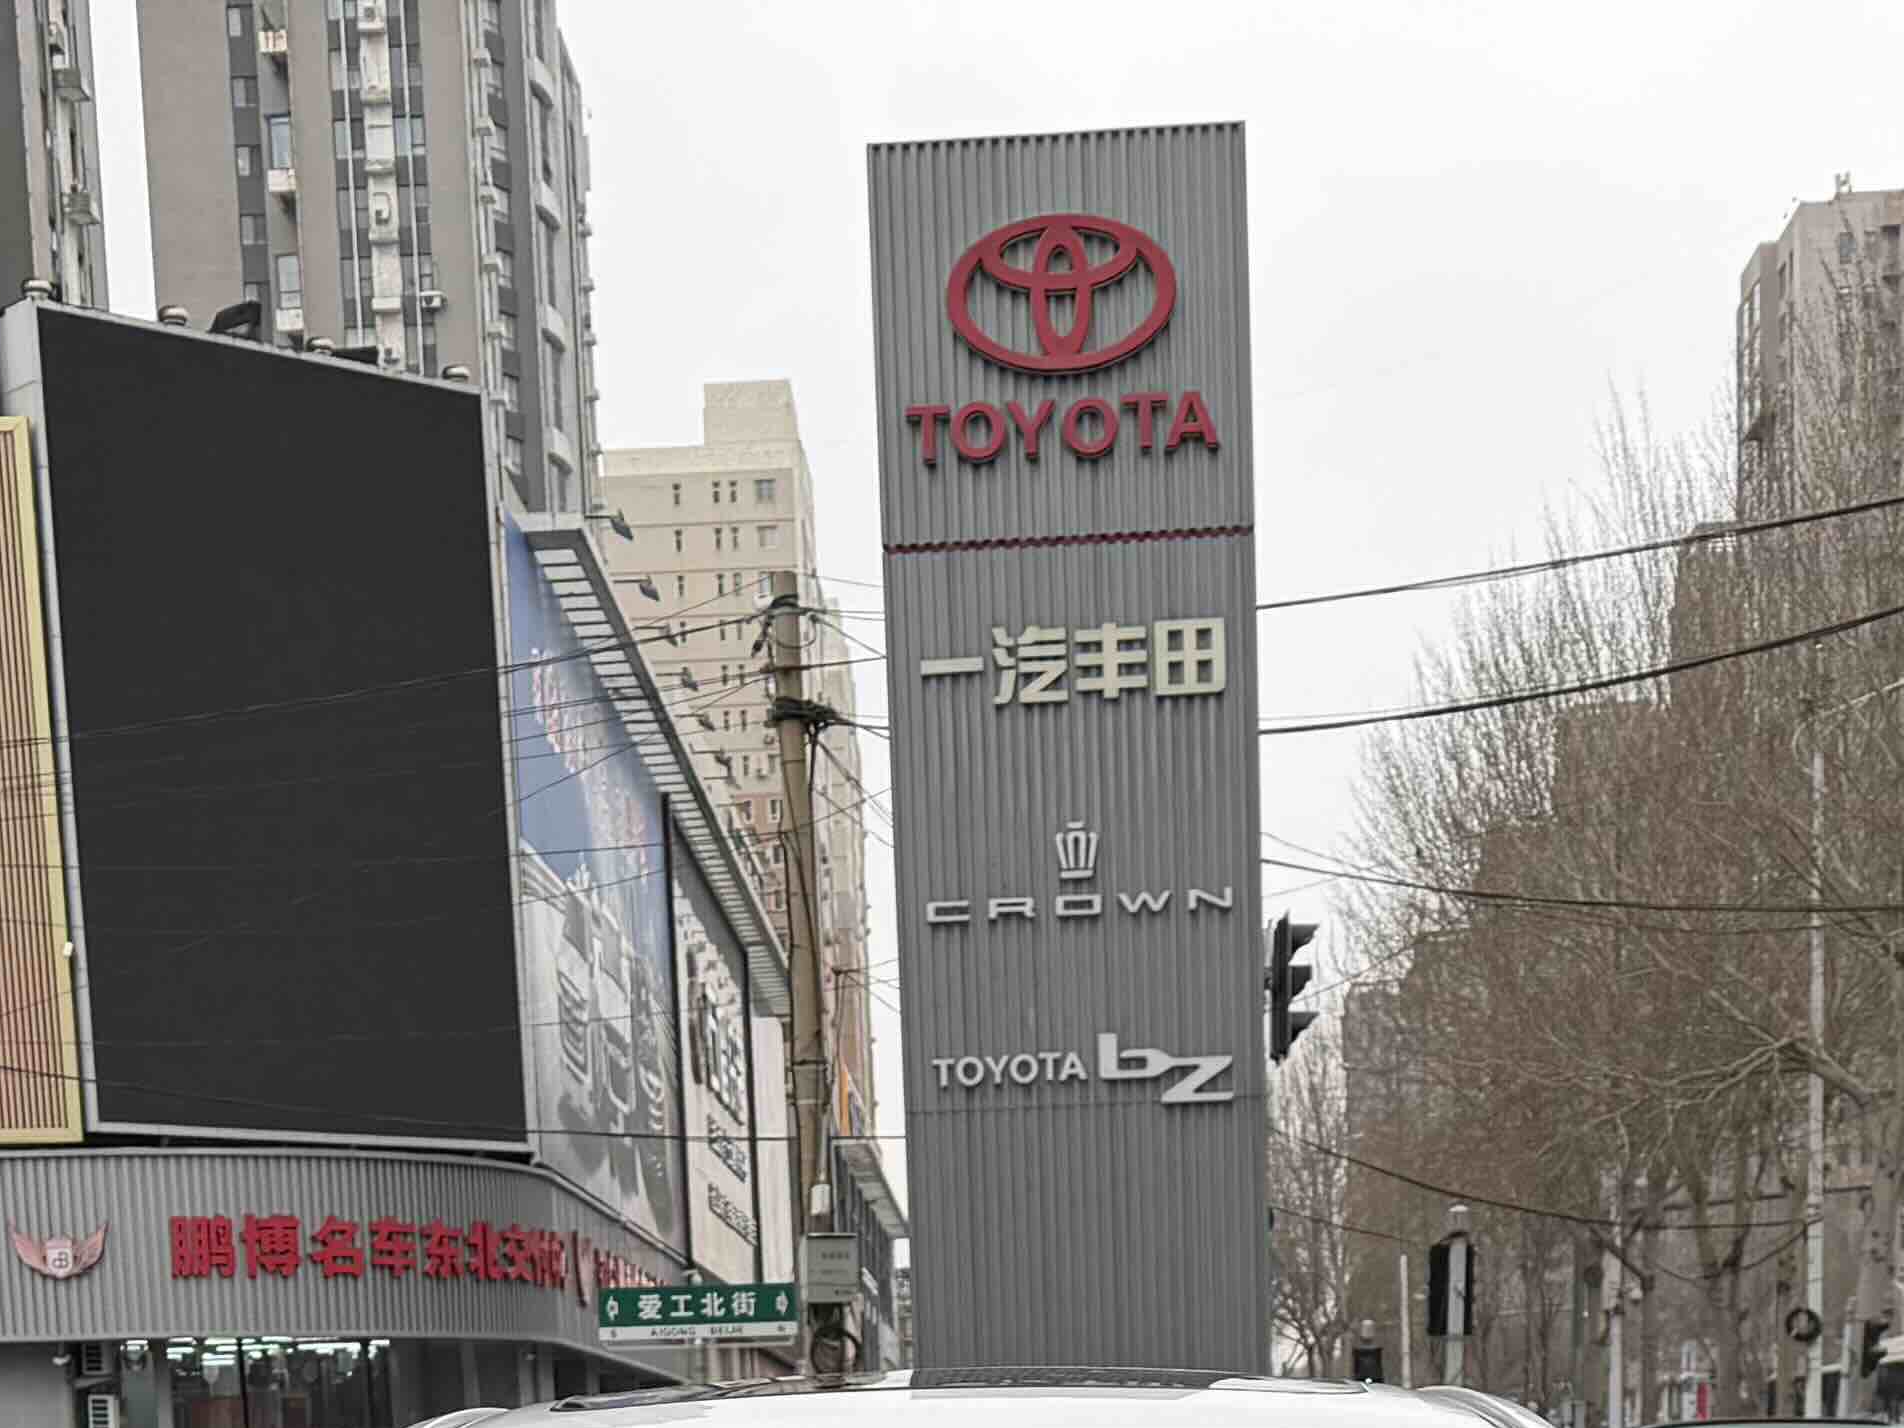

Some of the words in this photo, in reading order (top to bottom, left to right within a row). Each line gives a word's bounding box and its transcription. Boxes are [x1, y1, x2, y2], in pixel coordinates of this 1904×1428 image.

[904, 390, 1220, 464] TOYOTA
[919, 617, 1227, 706] 一汽丰田
[925, 886, 1234, 925] CROWN
[932, 1050, 1086, 1090] TOYOTA
[637, 1291, 757, 1320] 爱工北街
